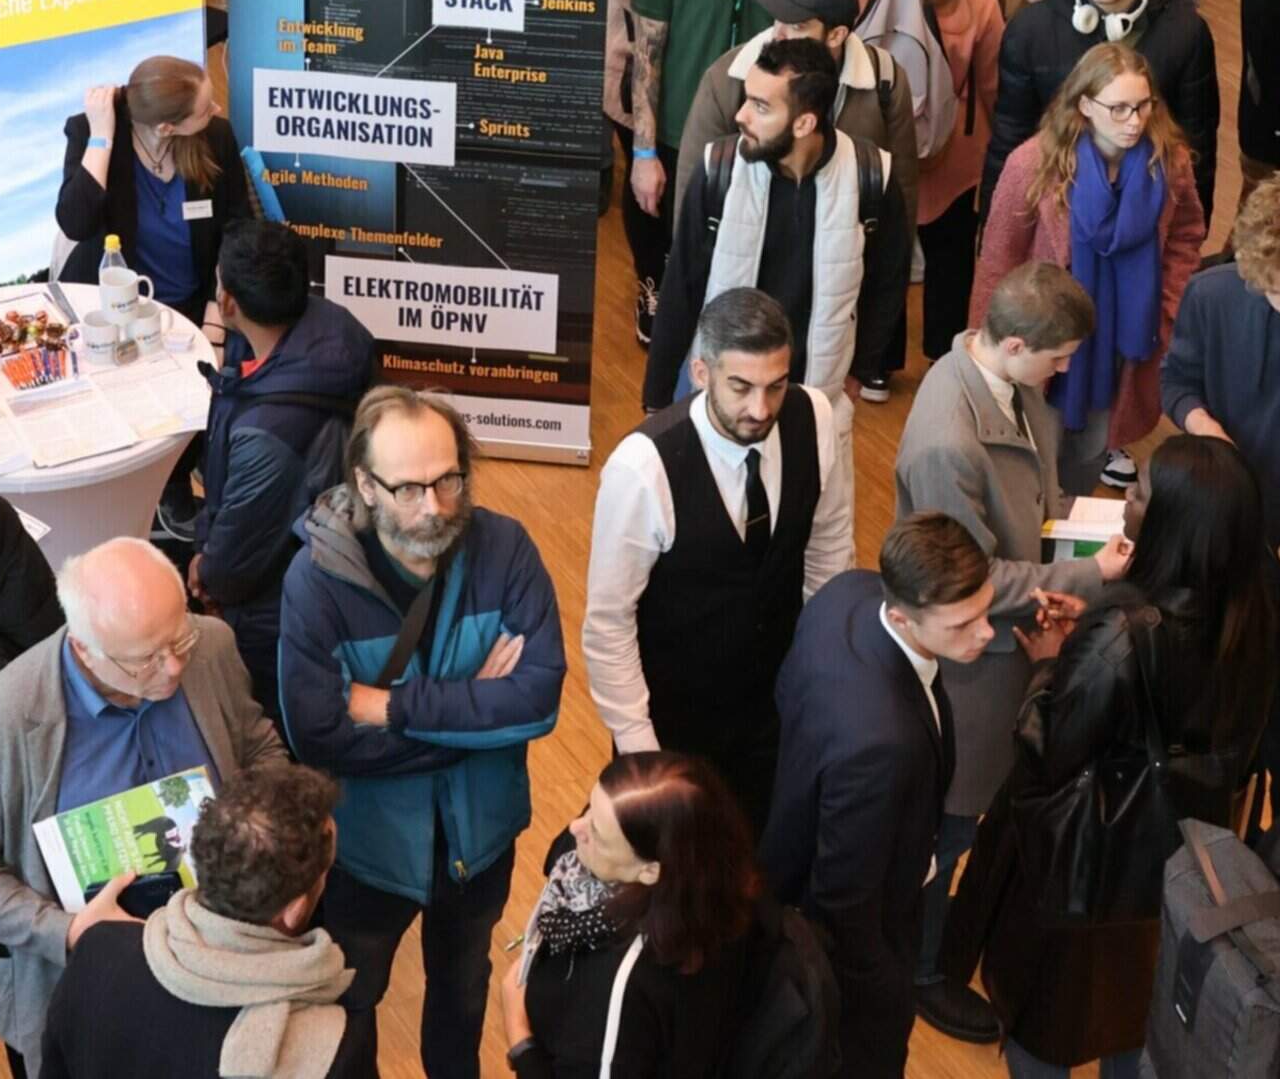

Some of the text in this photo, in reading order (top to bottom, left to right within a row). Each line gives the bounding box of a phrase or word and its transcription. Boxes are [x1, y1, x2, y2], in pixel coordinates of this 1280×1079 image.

[277, 18, 365, 42] Entwicklung
[278, 36, 337, 56] im Team
[474, 43, 504, 65] Java
[474, 63, 548, 84] Enterprise
[268, 86, 441, 121] ENTWICKLUNGS-
[275, 114, 433, 148] ORGANISATION
[479, 118, 530, 140] Sprints
[262, 167, 368, 191] Agile Methoden
[350, 226, 444, 248] Themenfelder
[343, 275, 544, 311] ELEKTROMOBILITÄT
[398, 304, 488, 334] IM ÖPNV
[383, 354, 558, 383] Klimaschutz voranbringen
